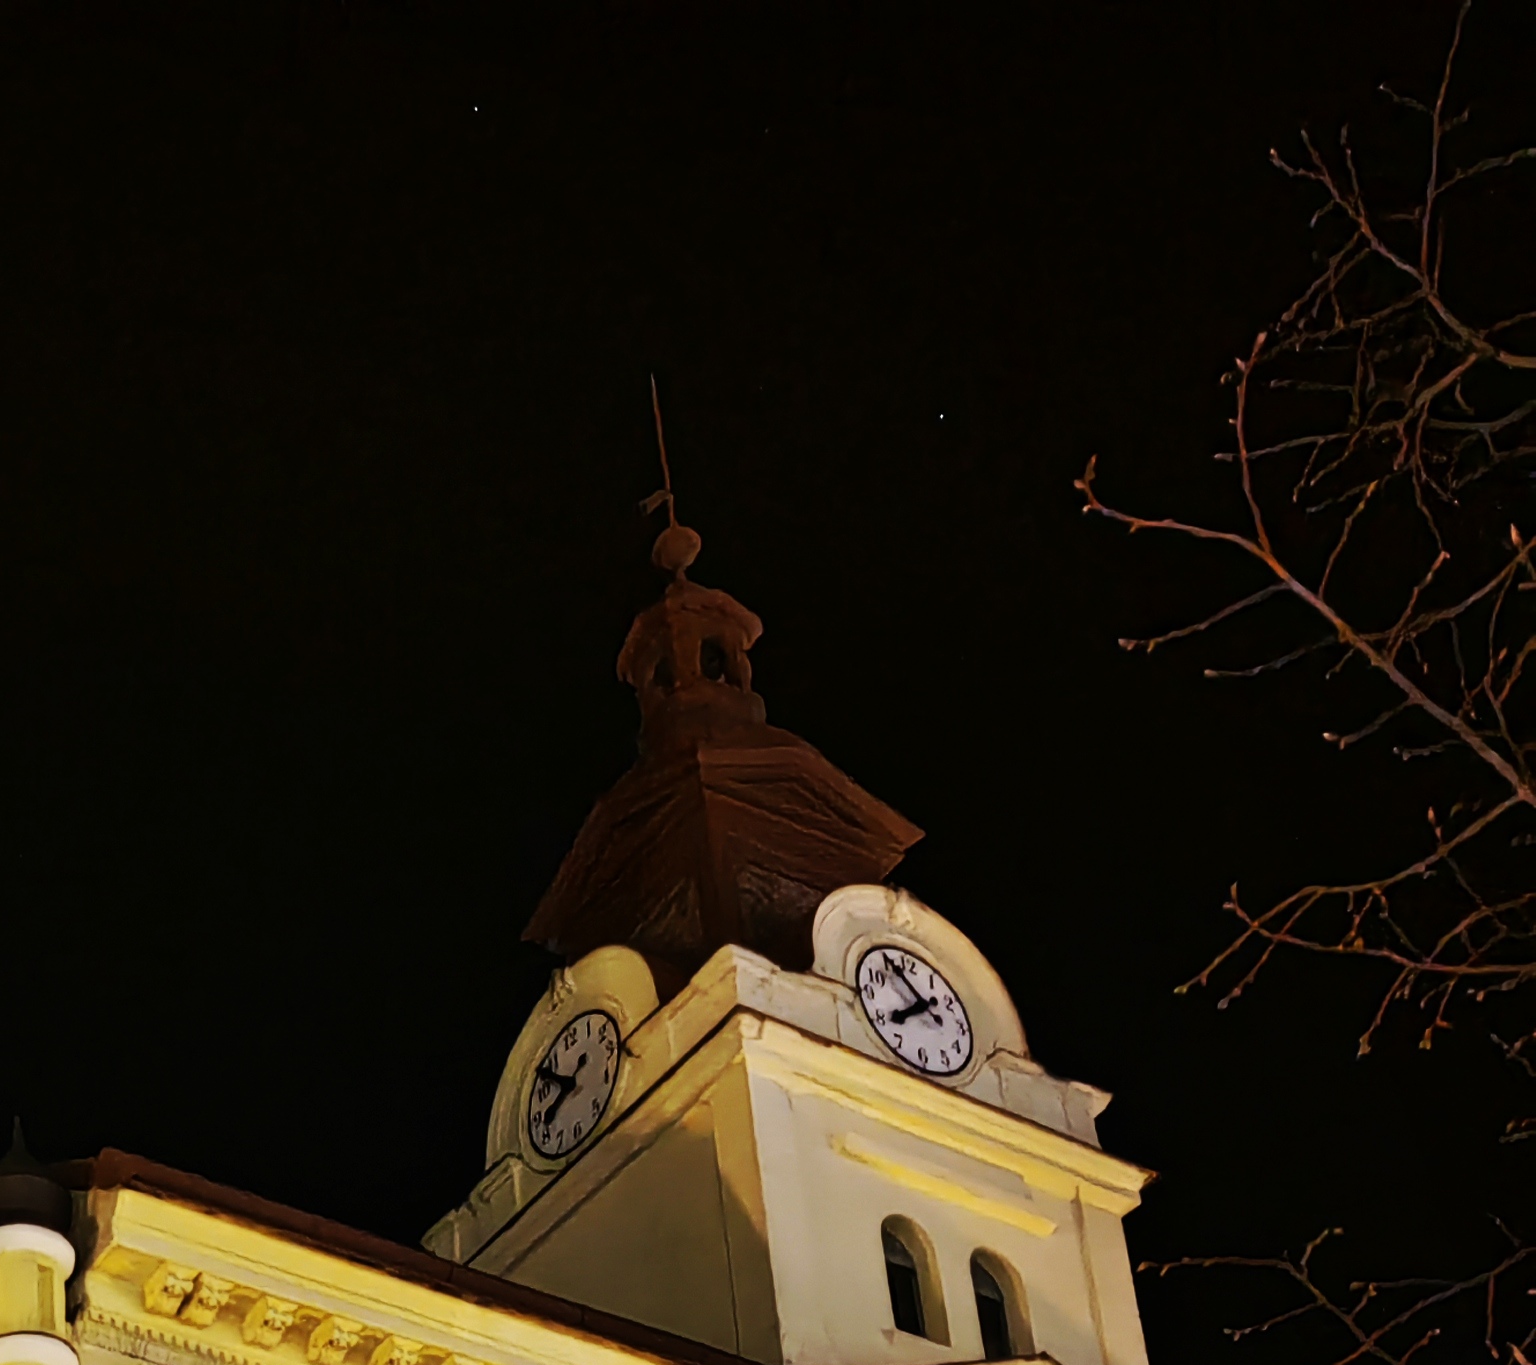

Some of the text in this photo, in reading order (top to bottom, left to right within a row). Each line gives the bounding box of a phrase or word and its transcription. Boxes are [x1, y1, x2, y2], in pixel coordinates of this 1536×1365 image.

[900, 955, 918, 976] 12
[869, 968, 886, 988] 10
[929, 974, 934, 990] 1
[944, 995, 955, 1014] 2
[876, 1009, 886, 1026] 8
[564, 1027, 578, 1051] 12
[586, 1020, 591, 1039] 1
[894, 1032, 903, 1048] 7
[951, 1039, 961, 1054] 4
[918, 1047, 928, 1064] 6
[940, 1049, 951, 1068] 5
[538, 1080, 551, 1103] 10
[556, 1129, 564, 1153] 7
